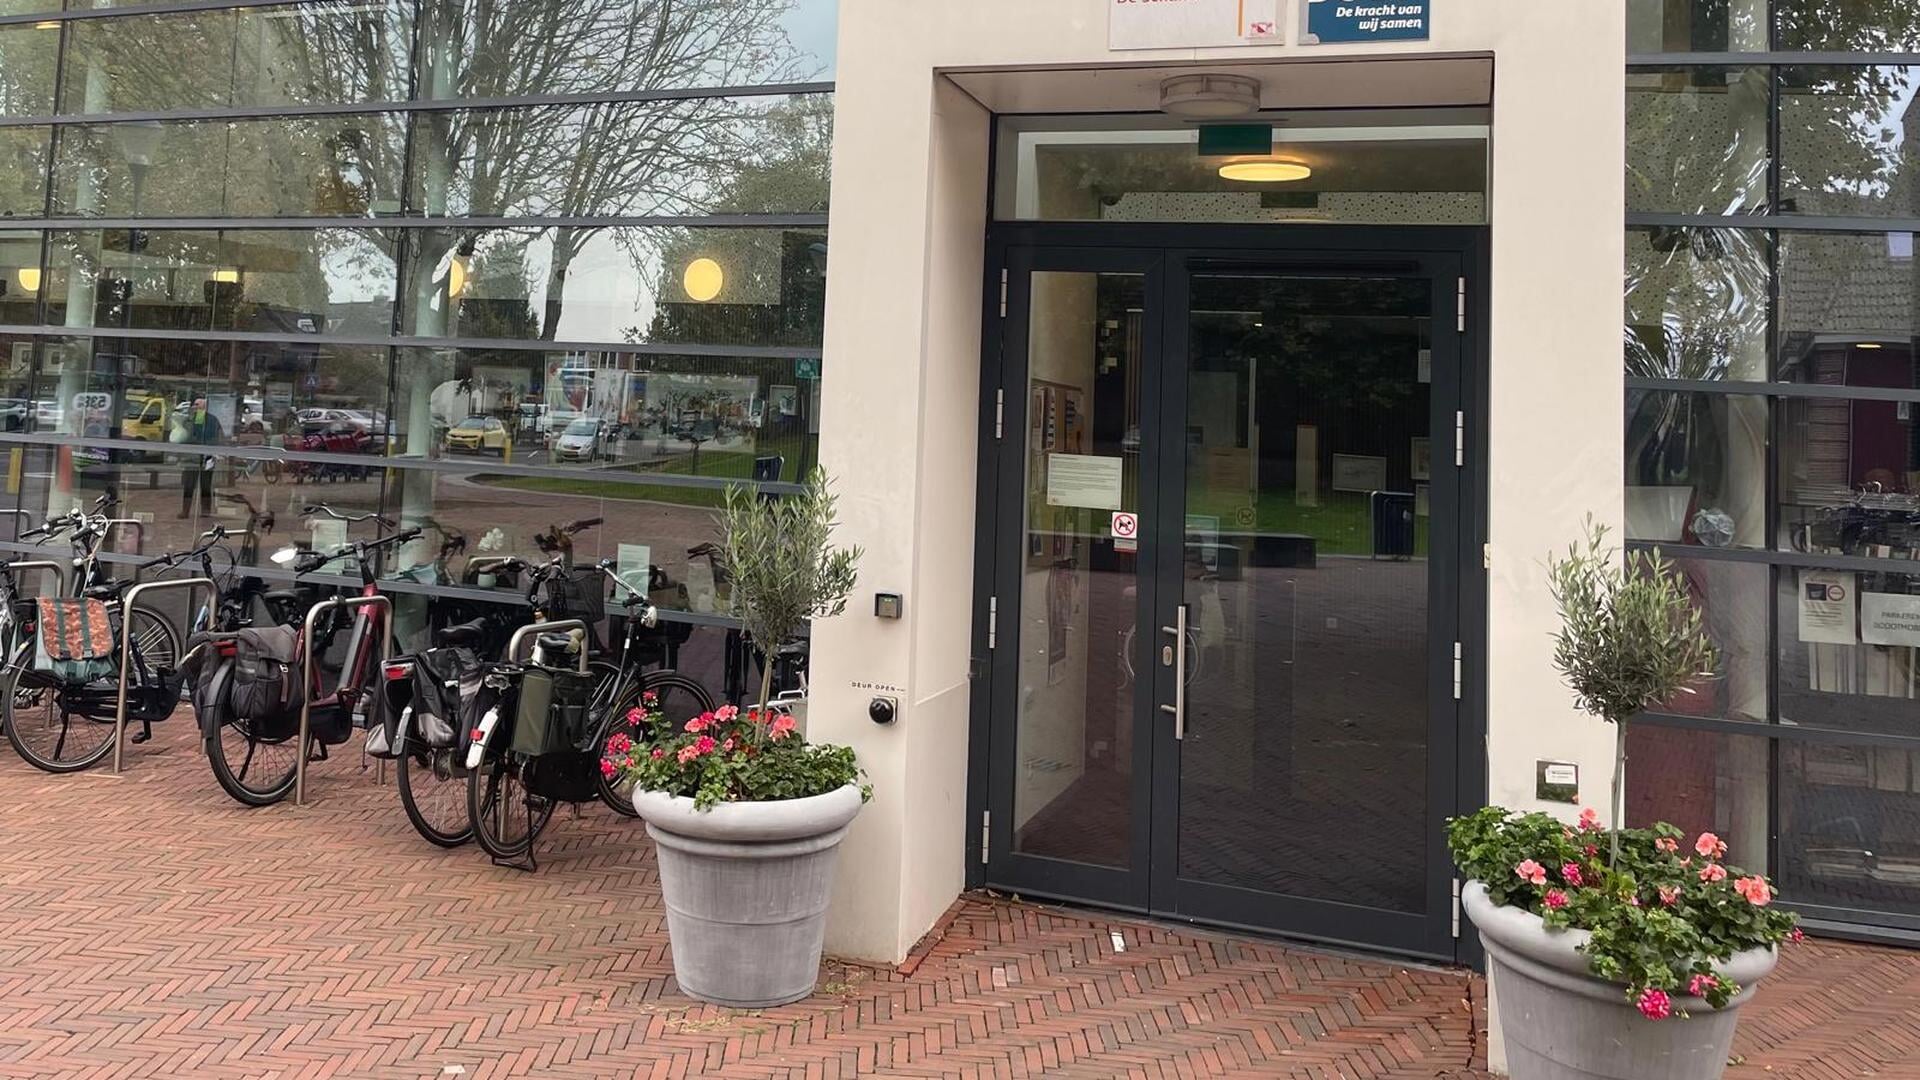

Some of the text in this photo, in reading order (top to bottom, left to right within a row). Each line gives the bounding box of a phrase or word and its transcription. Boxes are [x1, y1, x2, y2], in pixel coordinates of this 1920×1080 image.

[1336, 5, 1422, 17] De kracht van
[1359, 18, 1422, 32] wij samen
[851, 681, 896, 692] DEUR OPEN
